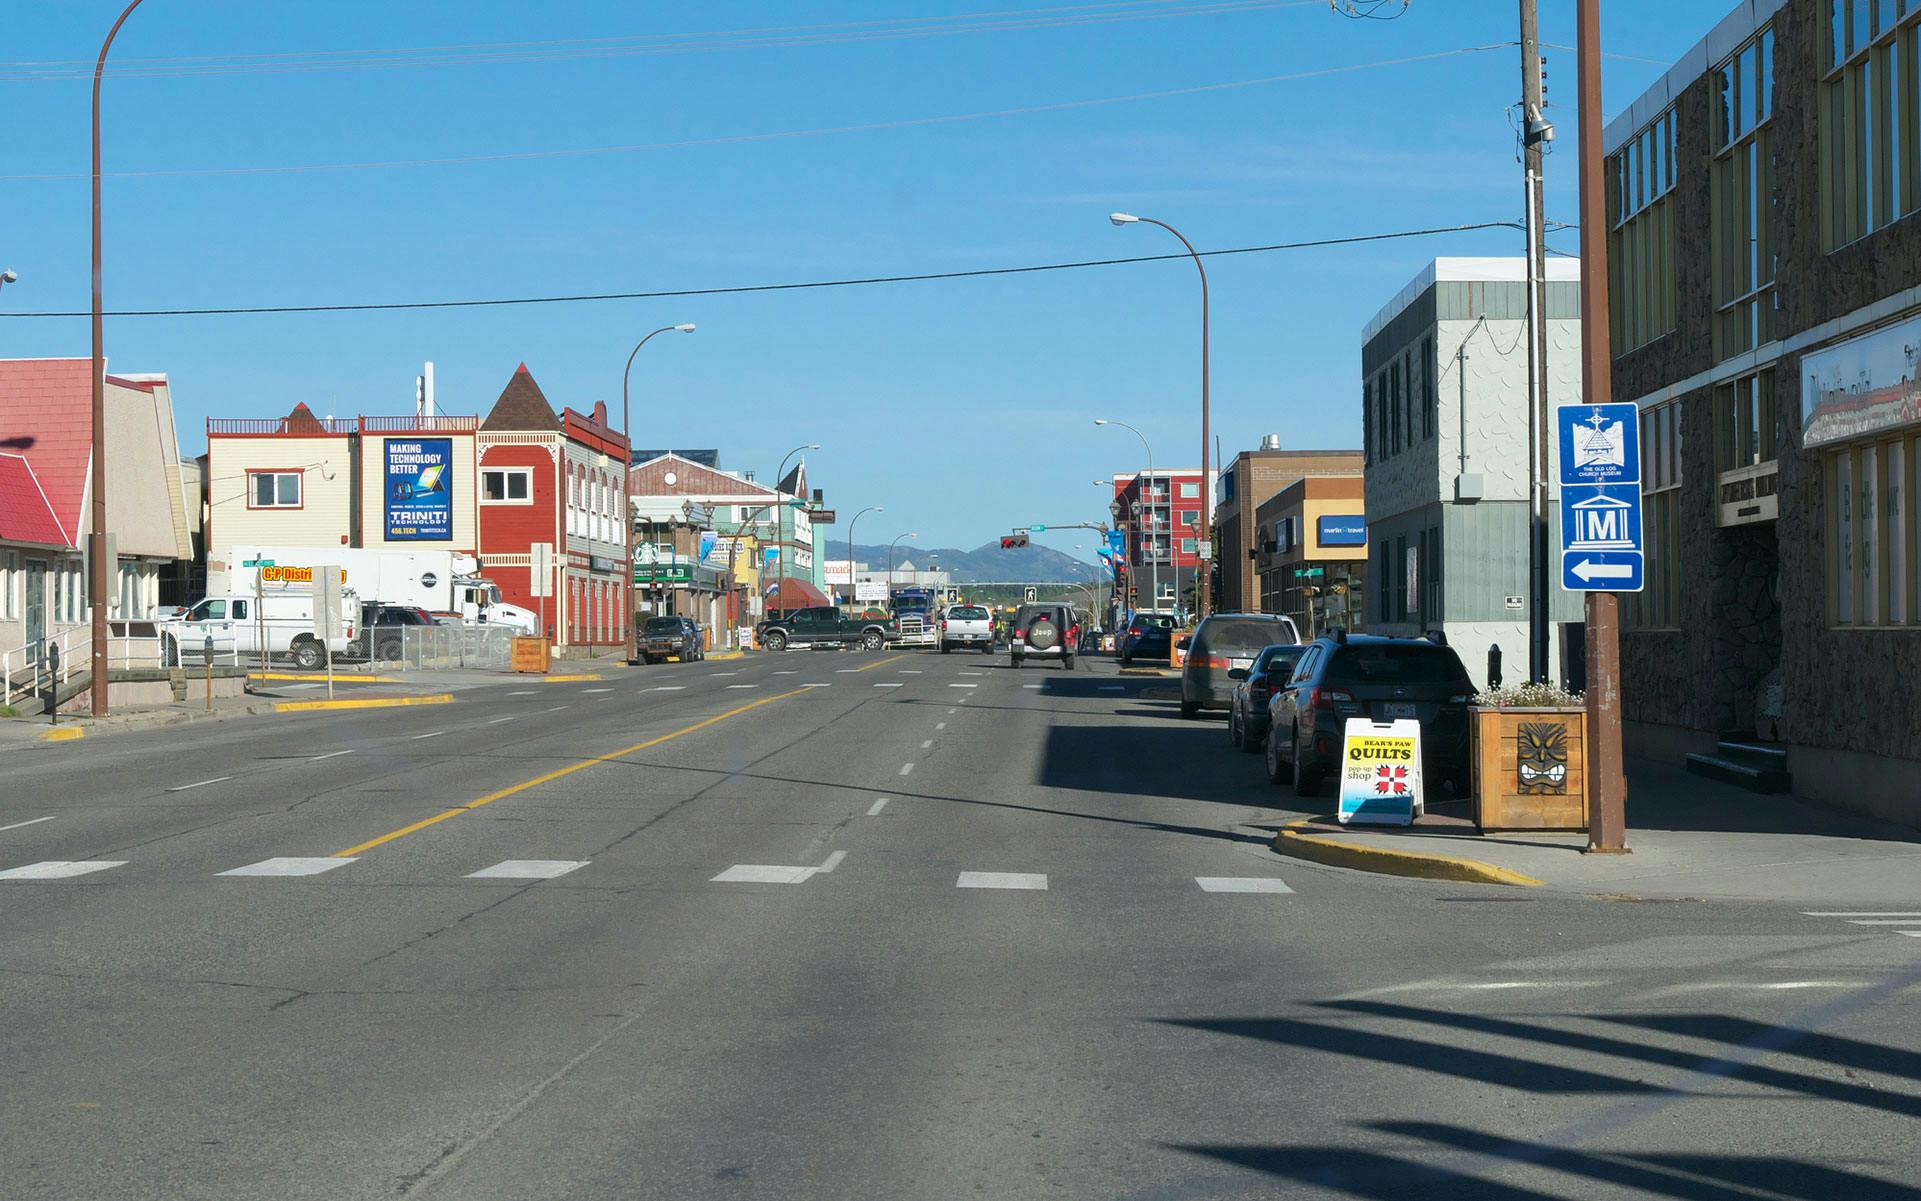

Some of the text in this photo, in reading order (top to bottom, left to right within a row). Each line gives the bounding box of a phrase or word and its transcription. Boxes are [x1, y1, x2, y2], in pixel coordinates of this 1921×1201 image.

[390, 444, 421, 453] MAKING
[390, 454, 441, 463] TECHNOLOGY
[390, 465, 418, 474] BETTER
[390, 512, 447, 520] TRINITI
[1588, 511, 1616, 539] M
[1033, 629, 1052, 637] Jeep
[1350, 748, 1411, 760] QUILTS
[1348, 772, 1372, 781] shop
